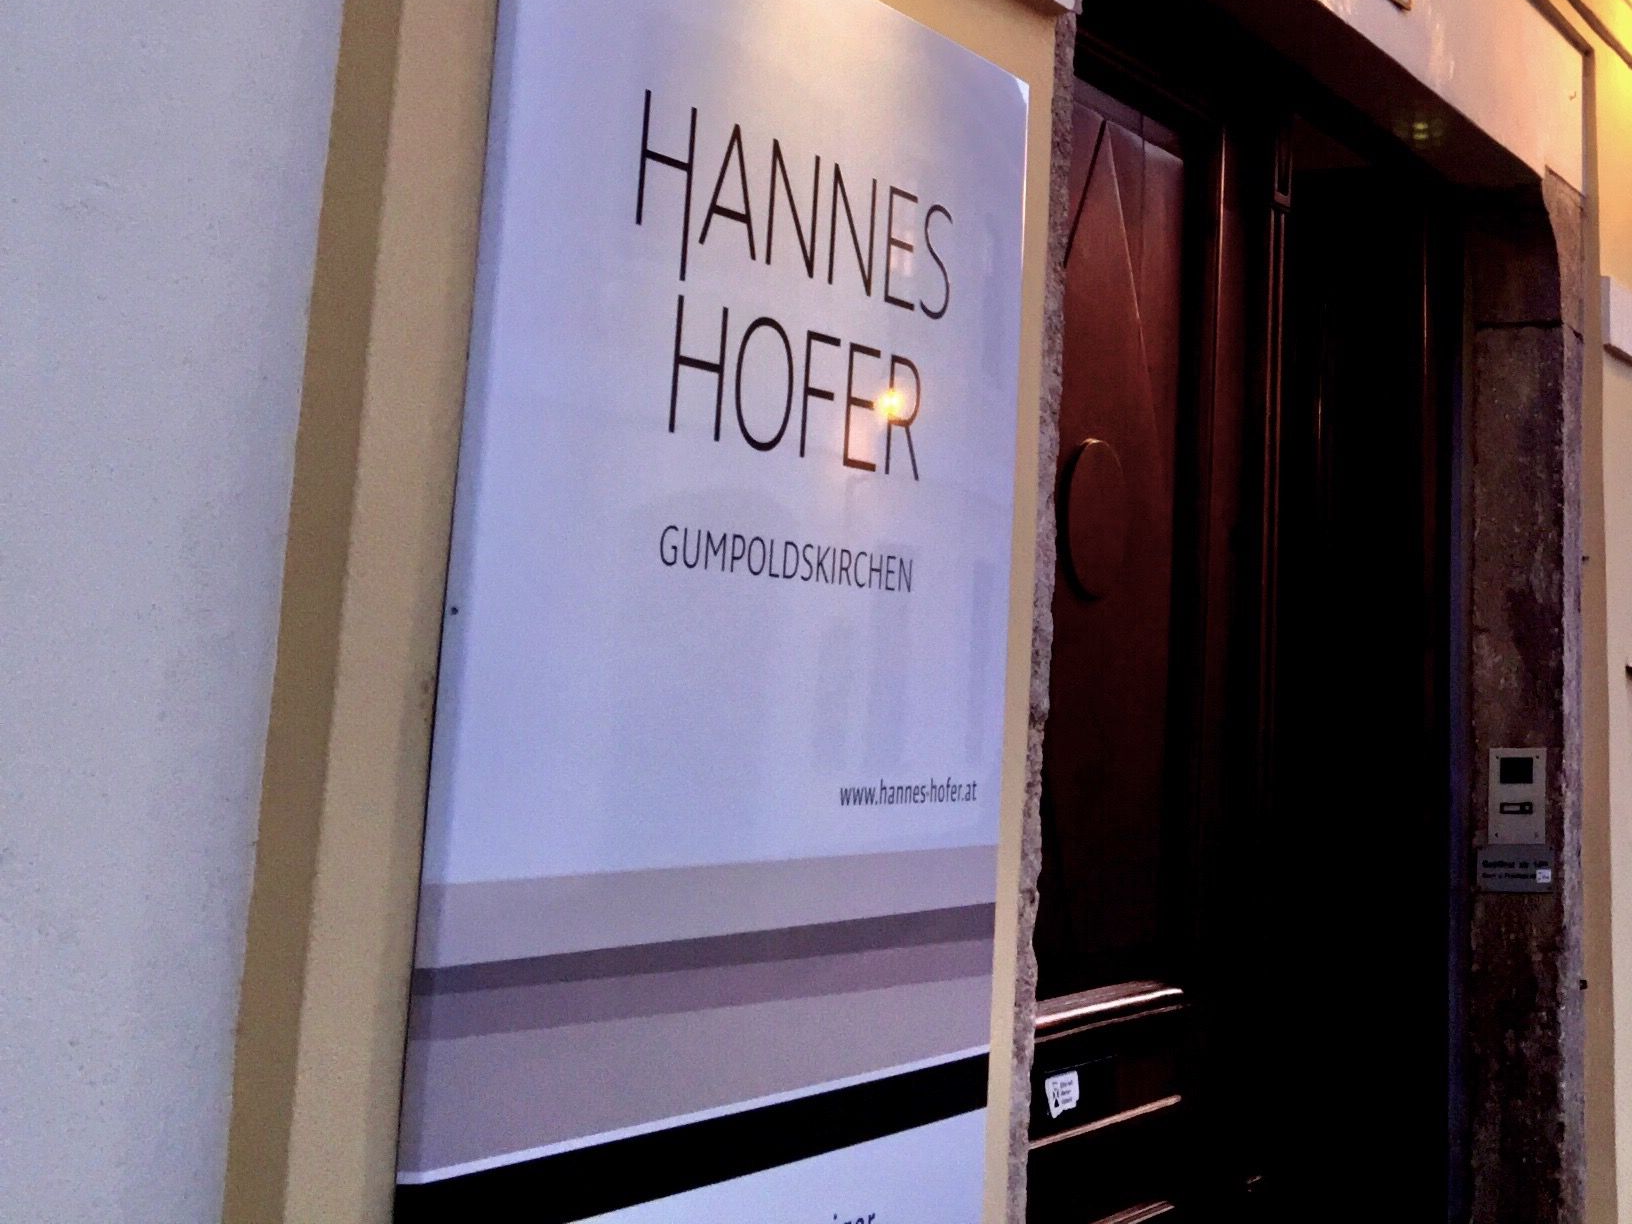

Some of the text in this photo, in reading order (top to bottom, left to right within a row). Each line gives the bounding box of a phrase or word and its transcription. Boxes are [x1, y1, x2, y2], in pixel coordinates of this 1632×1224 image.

[635, 89, 954, 321] HANNES
[668, 294, 920, 481] HOFER
[659, 524, 914, 594] GUMPOLDSKIRCHEN
[839, 777, 978, 806] www.hannes-hofer.at
